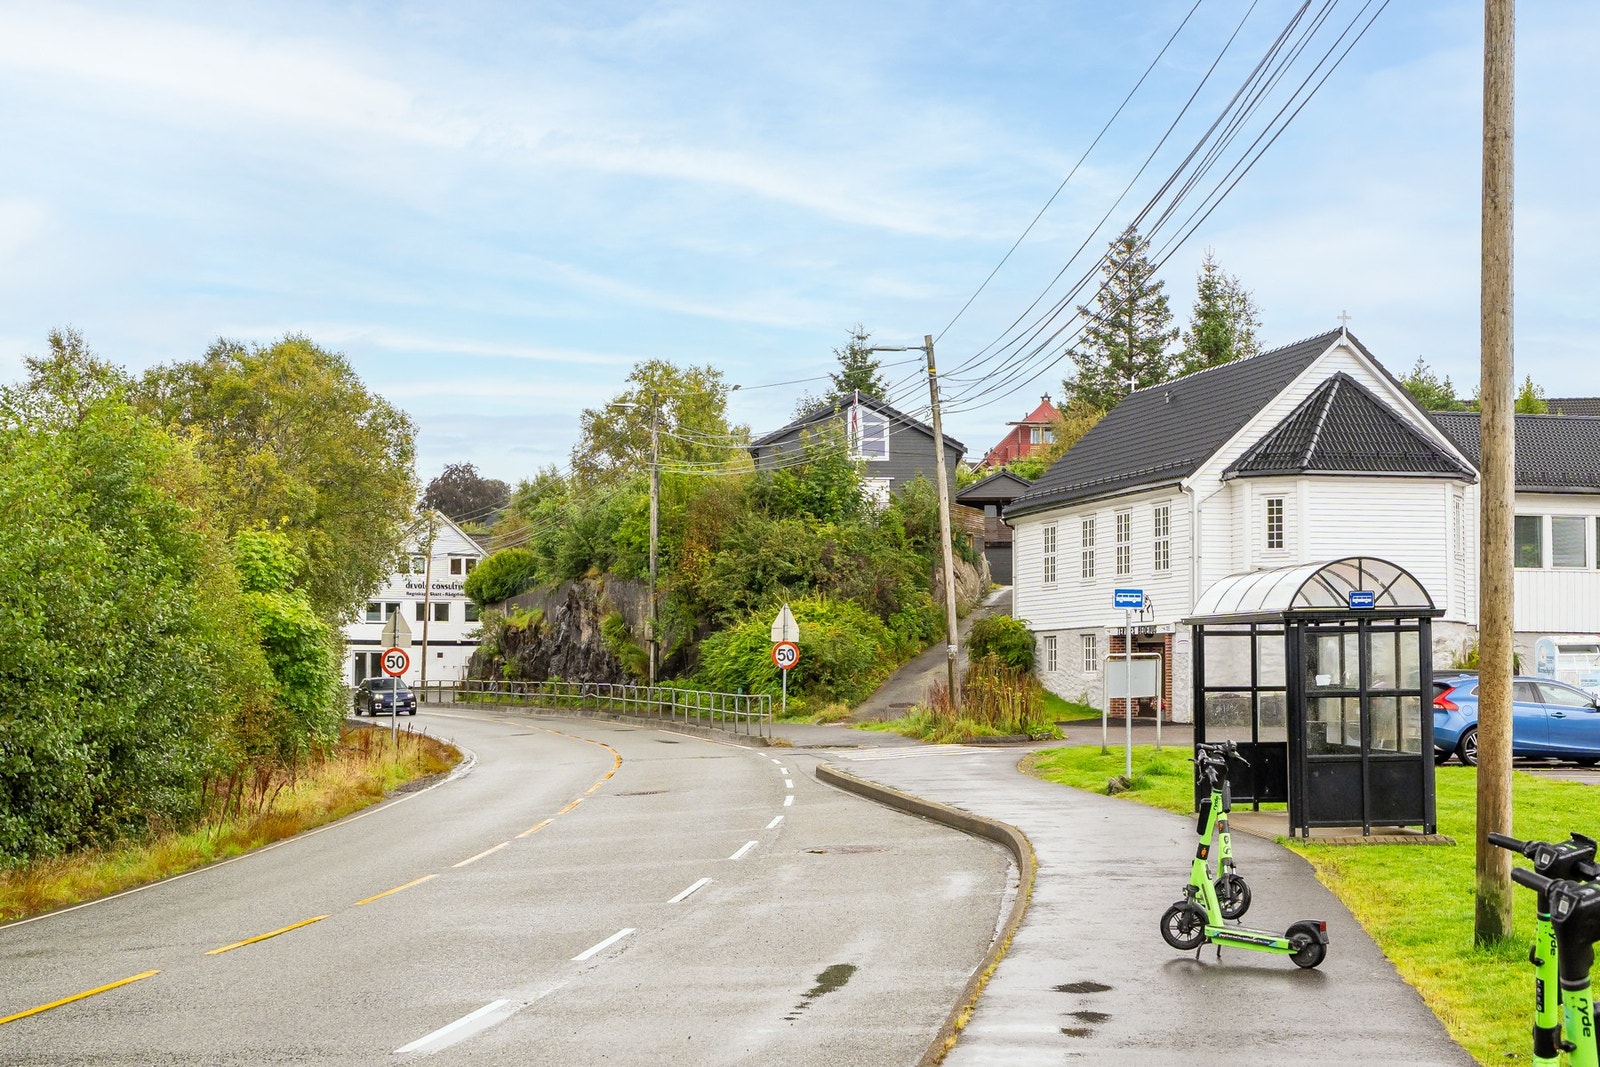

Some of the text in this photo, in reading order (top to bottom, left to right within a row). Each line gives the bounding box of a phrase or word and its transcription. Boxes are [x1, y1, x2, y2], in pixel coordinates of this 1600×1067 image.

[386, 655, 405, 669] 50
[777, 648, 795, 662] 50
[1549, 926, 1557, 956] yde
[1578, 997, 1592, 1038] ryde
